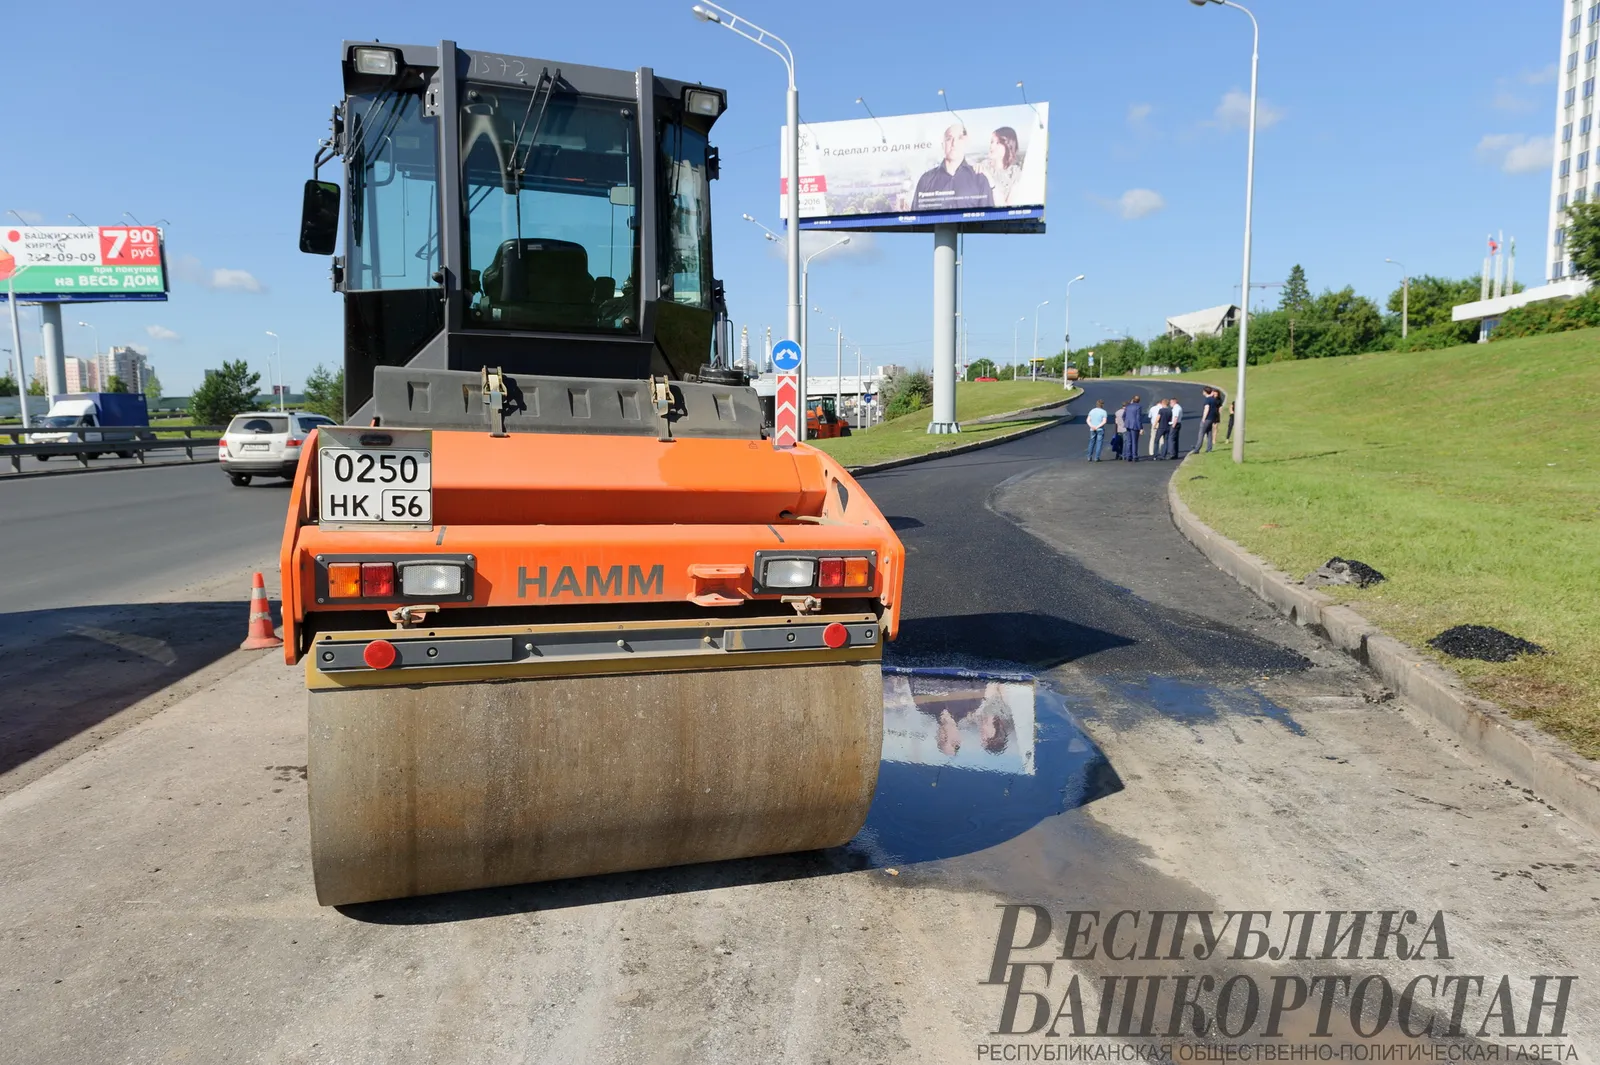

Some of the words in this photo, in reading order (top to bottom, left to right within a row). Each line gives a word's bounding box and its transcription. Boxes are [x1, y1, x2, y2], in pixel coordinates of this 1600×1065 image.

[823, 147, 830, 157] Я
[832, 146, 869, 156] сделал
[872, 145, 888, 154] это
[891, 143, 911, 153] для
[913, 141, 933, 150] нее
[102, 230, 127, 259] 7
[129, 229, 154, 244] 90
[27, 252, 96, 262] 22-09-09
[93, 266, 113, 274] при
[115, 266, 158, 274] покупке
[54, 277, 75, 287] на
[78, 274, 119, 287] ВЕСЬ
[123, 274, 160, 288] ДОМ
[334, 453, 418, 484] 0250
[391, 495, 423, 518] 56
[517, 564, 665, 599] HAMM
